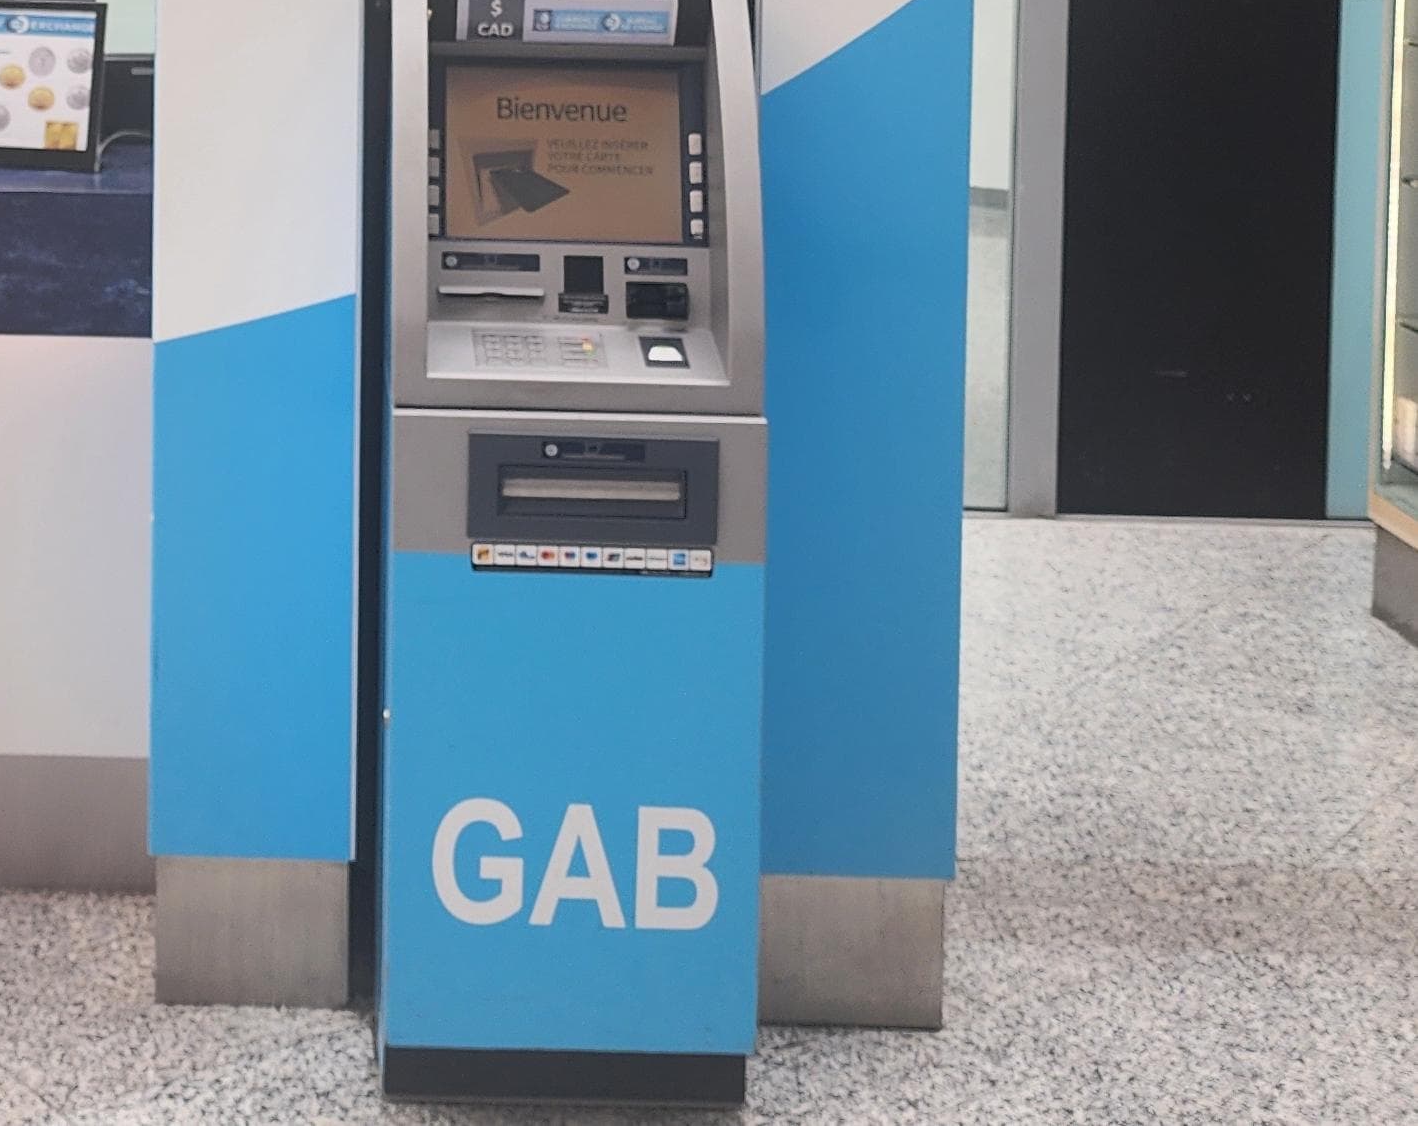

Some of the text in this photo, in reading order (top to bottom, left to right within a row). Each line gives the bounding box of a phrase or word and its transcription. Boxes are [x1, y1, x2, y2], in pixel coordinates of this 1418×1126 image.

[477, 21, 515, 38] CAD
[496, 95, 628, 123] Bienvenue
[432, 797, 719, 931] GAB
